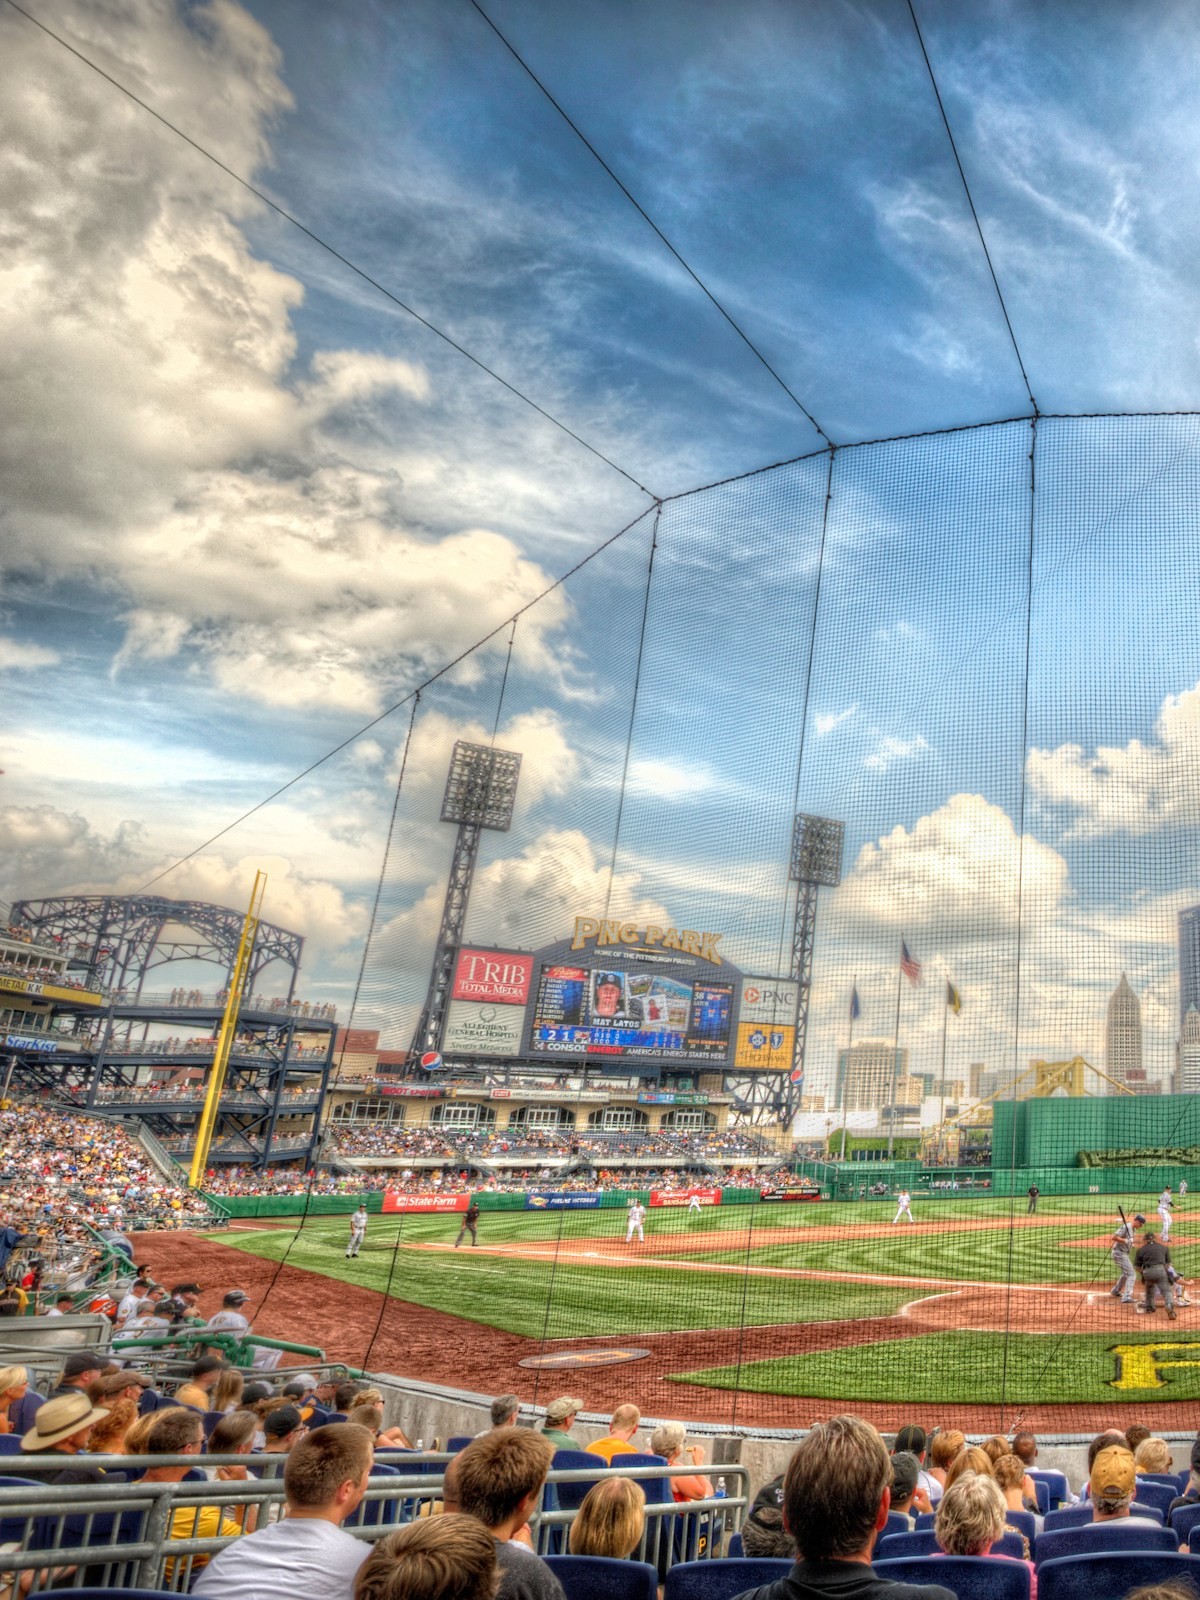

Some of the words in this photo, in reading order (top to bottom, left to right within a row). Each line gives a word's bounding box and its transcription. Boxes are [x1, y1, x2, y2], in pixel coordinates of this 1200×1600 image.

[571, 916, 639, 950] PNC
[645, 925, 723, 966] PARK
[463, 955, 525, 985] TRIB
[460, 981, 492, 993] TOTAL
[493, 984, 523, 997] MEDIA
[762, 990, 794, 1005] PNC
[593, 1018, 612, 1027] MAT
[613, 1019, 640, 1028] LATOS
[533, 1029, 541, 1039] 1
[548, 1030, 556, 1040] 2
[563, 1031, 570, 1041] 1
[8, 1036, 56, 1051] StarKist
[547, 1043, 586, 1052] CONSOL
[663, 1050, 688, 1058] ENERGY
[689, 1051, 709, 1059] STARTS
